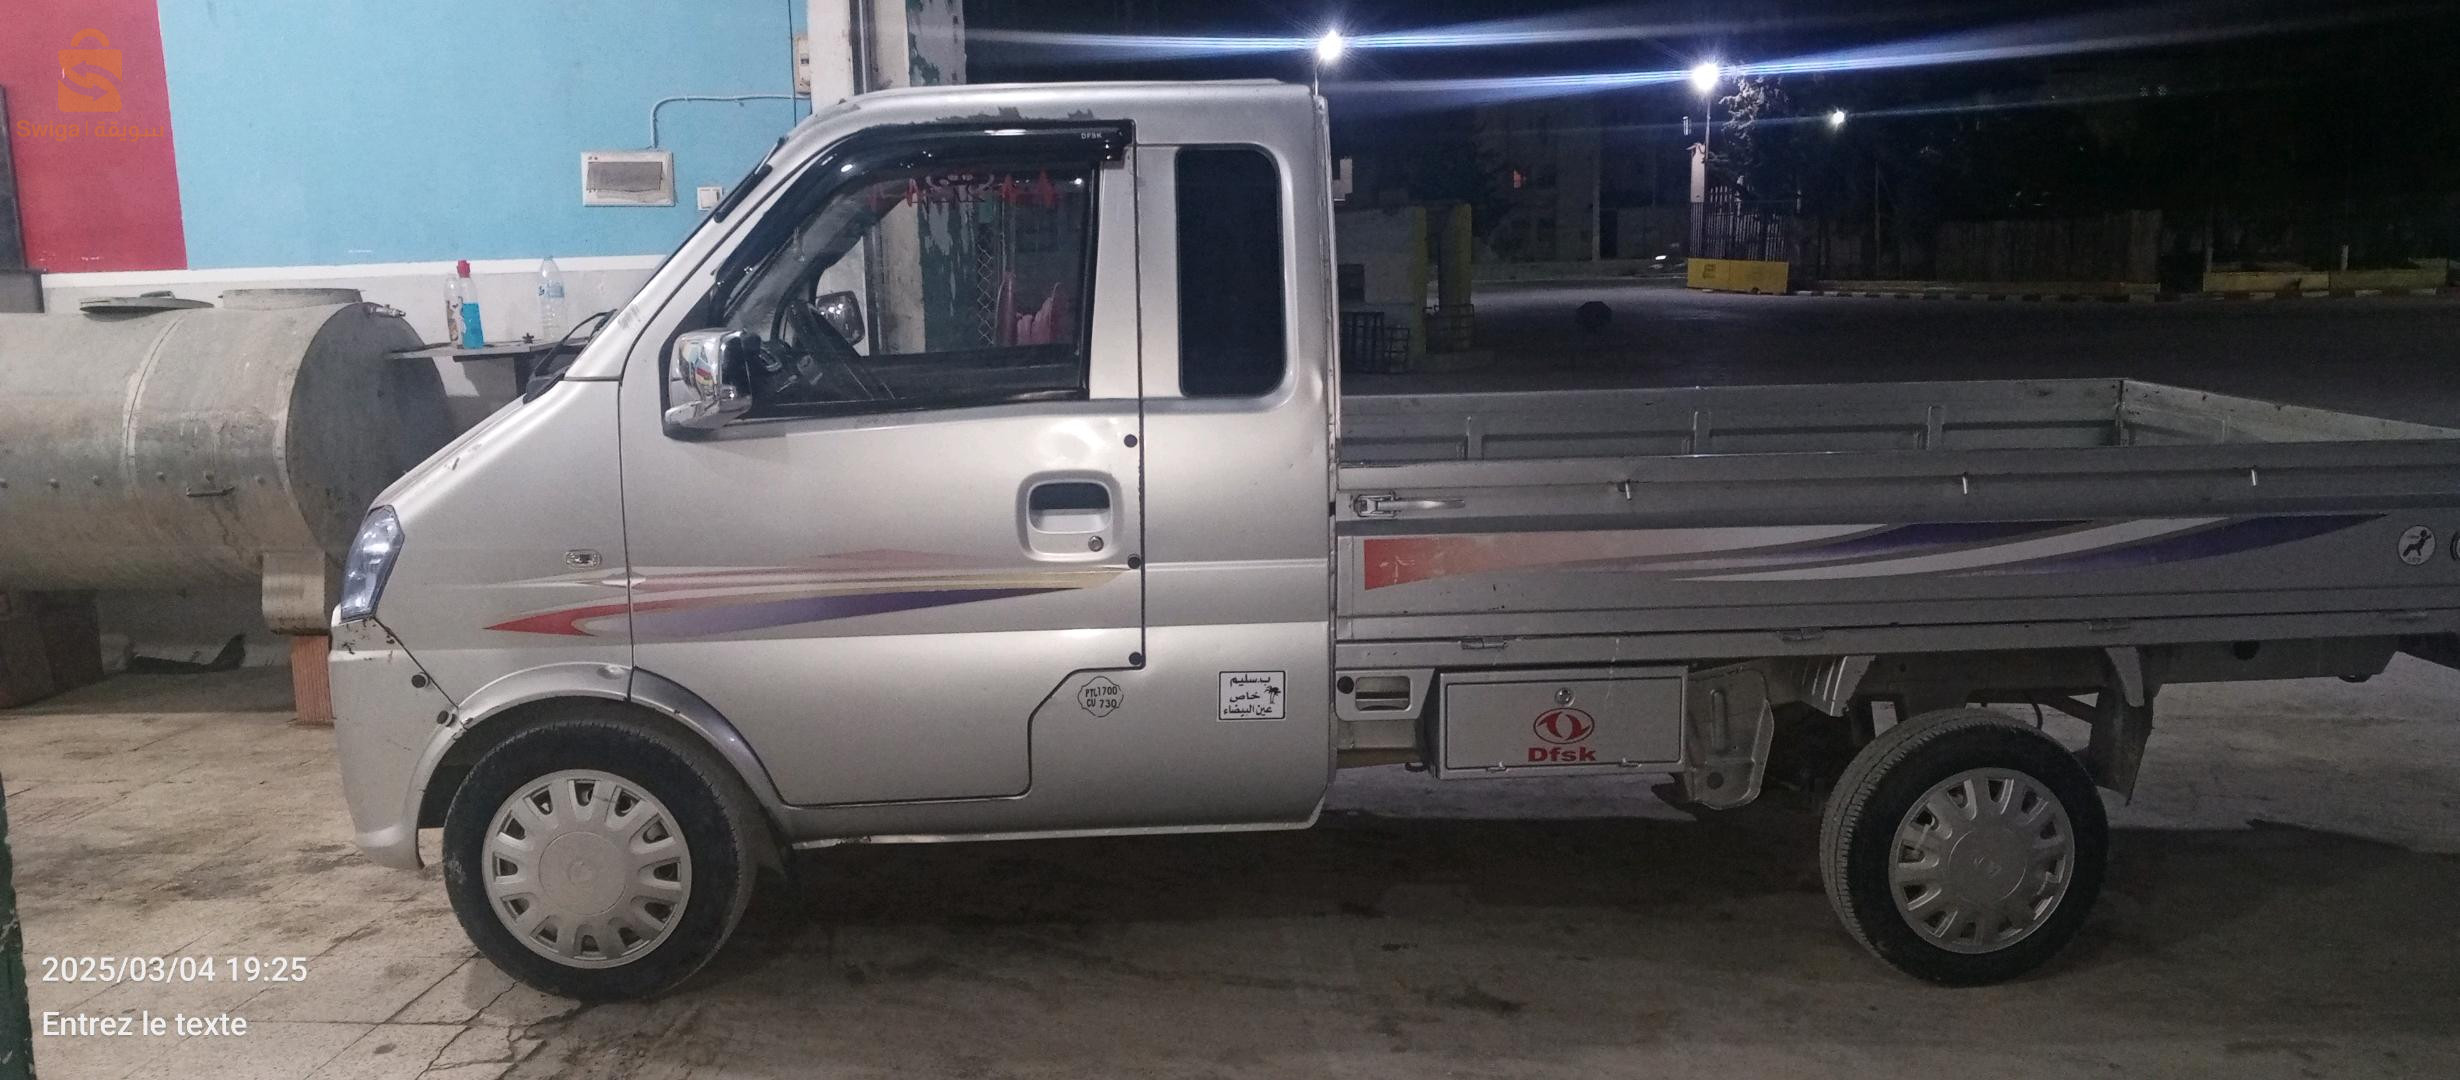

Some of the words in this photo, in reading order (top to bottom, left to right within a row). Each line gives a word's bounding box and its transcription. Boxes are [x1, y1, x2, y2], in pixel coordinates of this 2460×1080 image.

[1229, 691, 1260, 703] خاص
[1099, 698, 1117, 709] 730
[1223, 704, 1255, 717] البيضاء
[1256, 704, 1273, 716] عين
[1528, 746, 1597, 763] Dfsk
